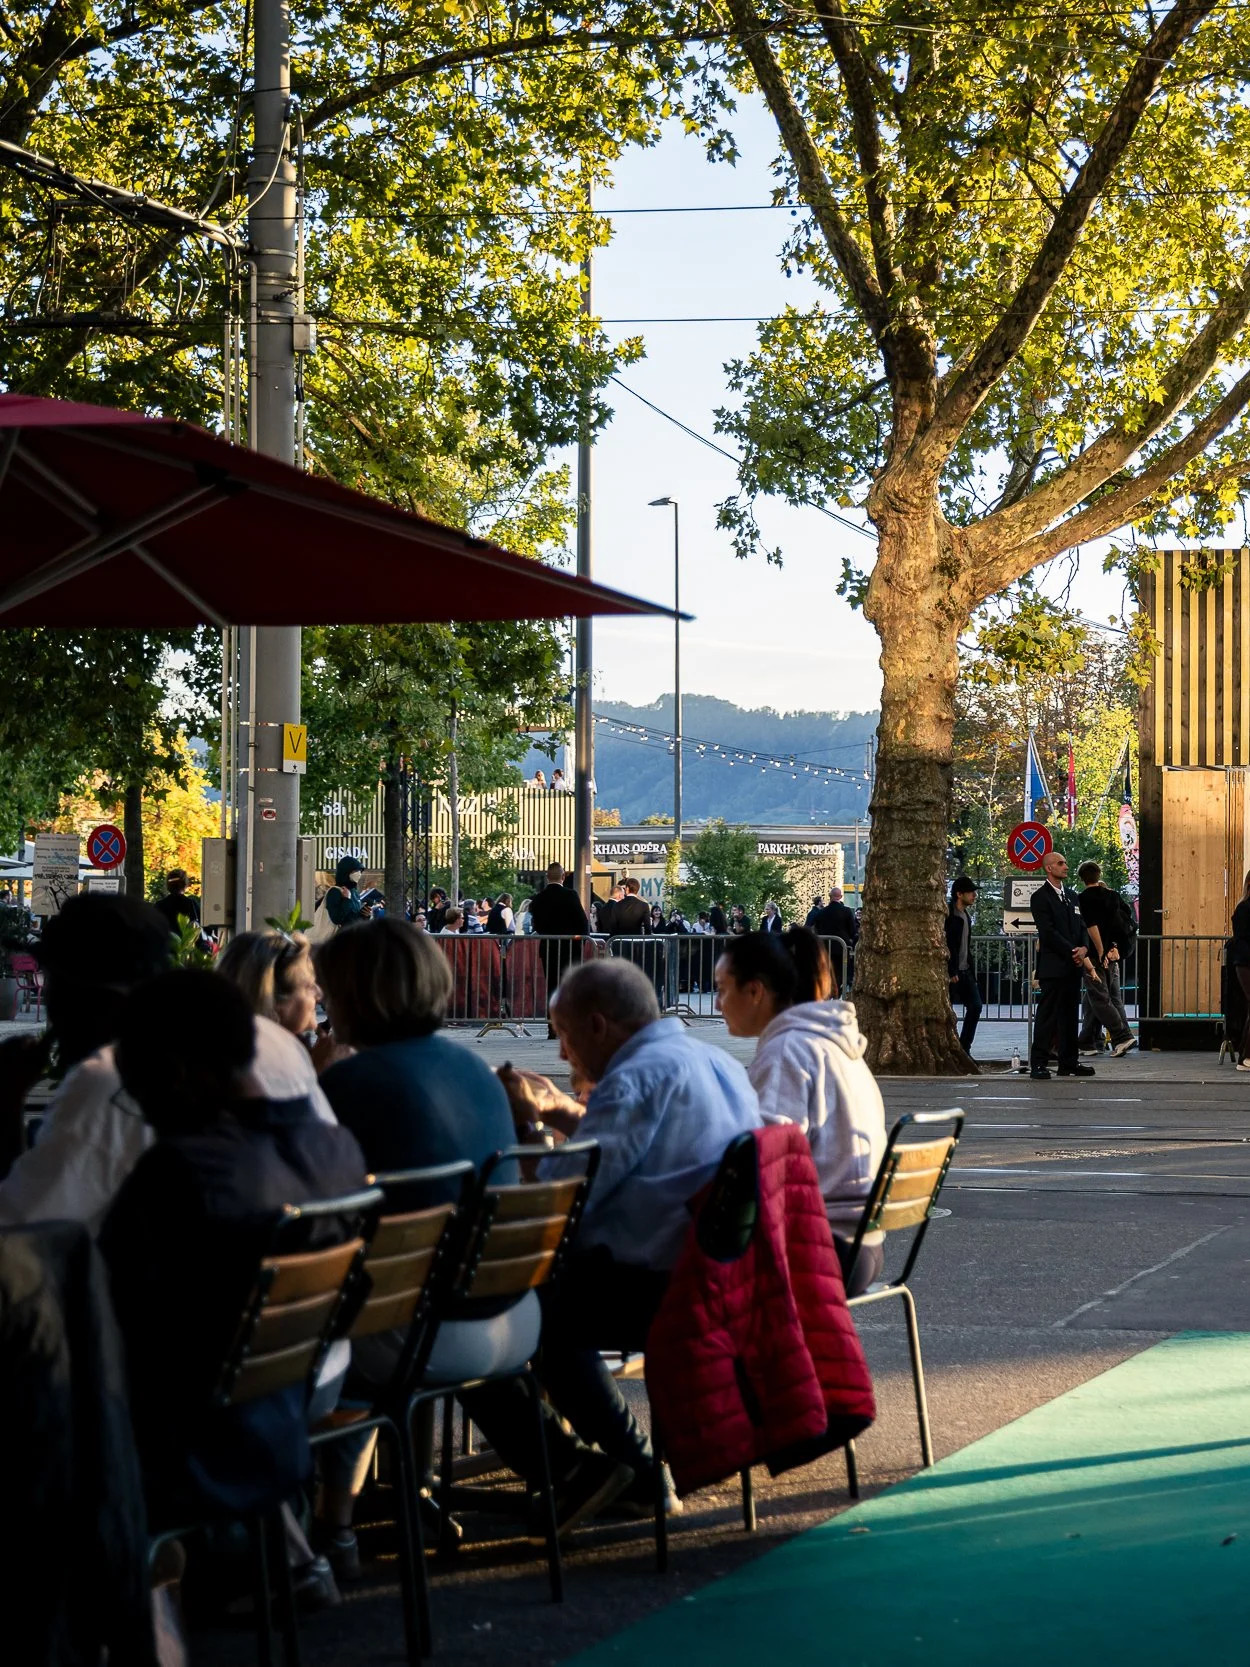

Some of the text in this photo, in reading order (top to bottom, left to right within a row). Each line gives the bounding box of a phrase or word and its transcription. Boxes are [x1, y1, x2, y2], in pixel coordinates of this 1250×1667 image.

[289, 731, 302, 754] V
[325, 846, 368, 860] GISADA
[632, 842, 667, 855] OPÉRA
[811, 842, 842, 855] OPÉR
[641, 877, 664, 897] MY
